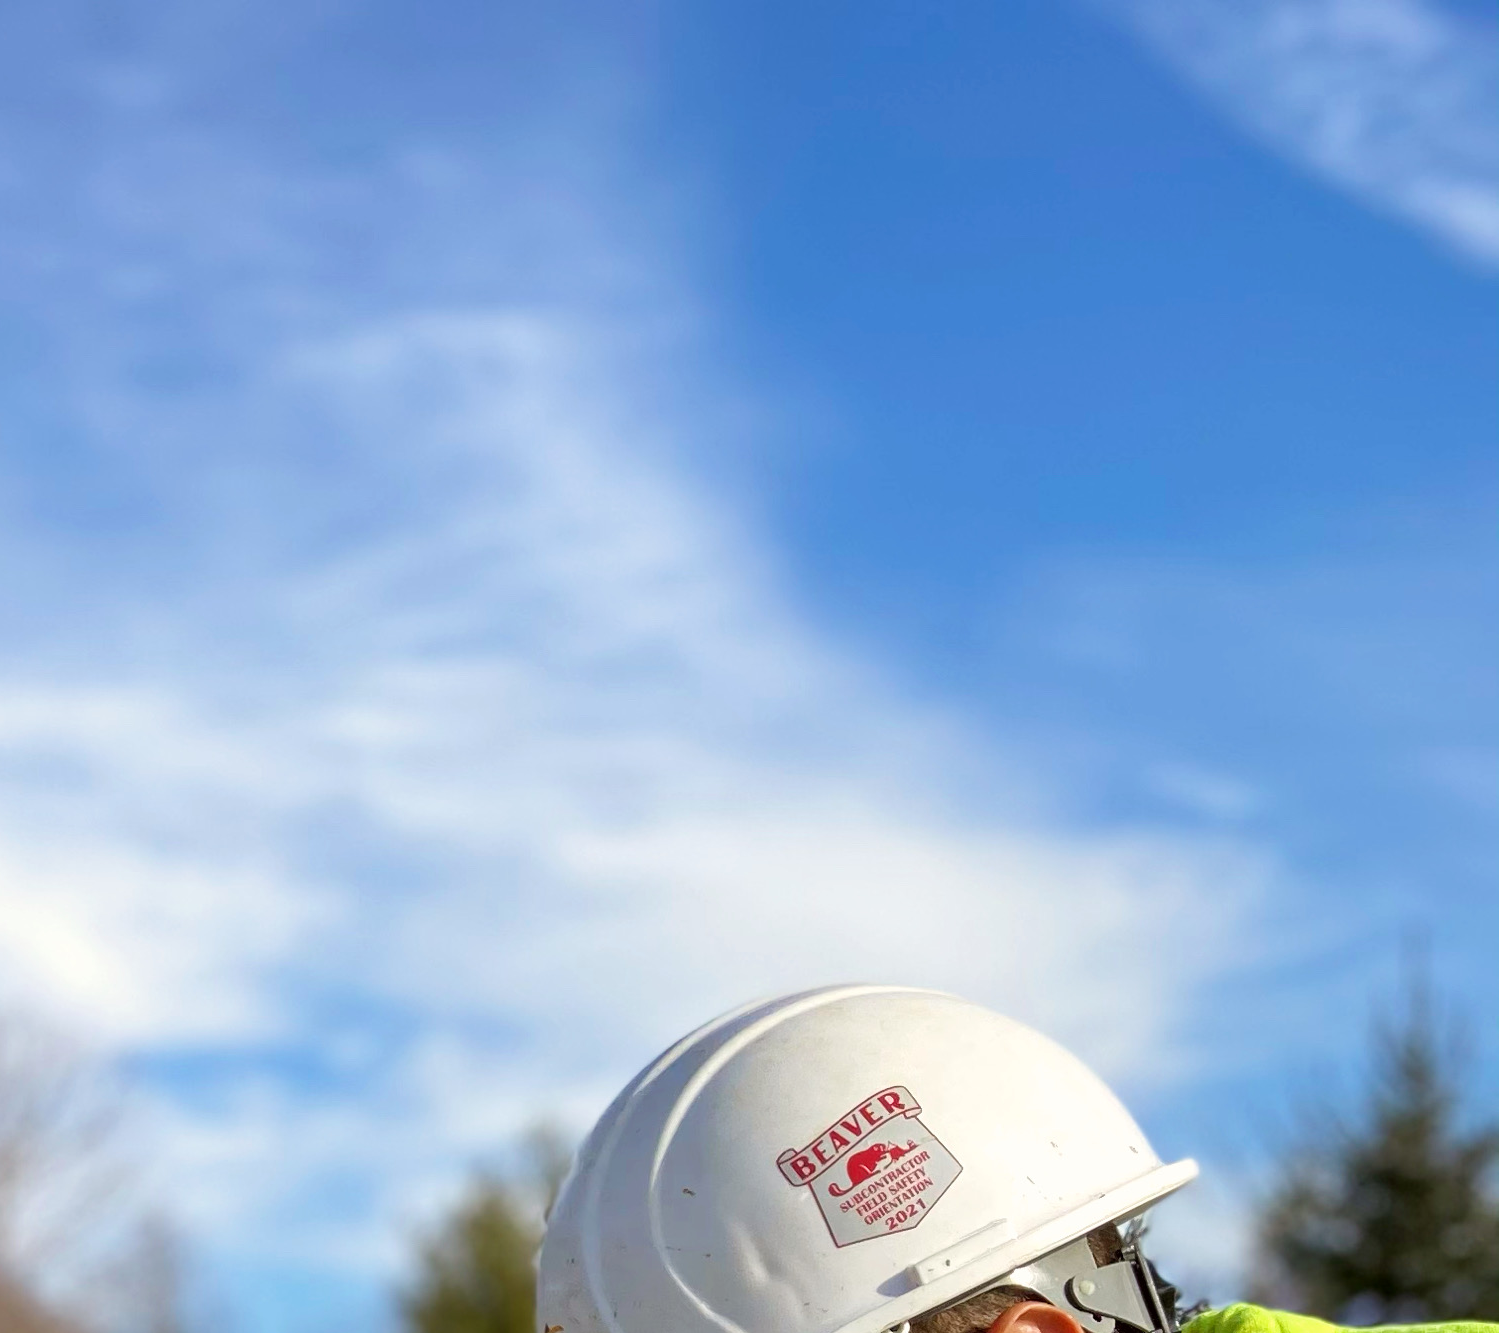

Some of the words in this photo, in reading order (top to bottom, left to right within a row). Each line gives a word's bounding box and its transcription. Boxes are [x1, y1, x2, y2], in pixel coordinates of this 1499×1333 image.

[790, 1091, 906, 1181] BEAVER
[840, 1150, 931, 1213] SUBCONTRACTOR
[856, 1192, 887, 1216] FIELD
[888, 1166, 926, 1195] SAFETY
[864, 1176, 933, 1225] ORIENTATION
[885, 1198, 926, 1230] 2021
